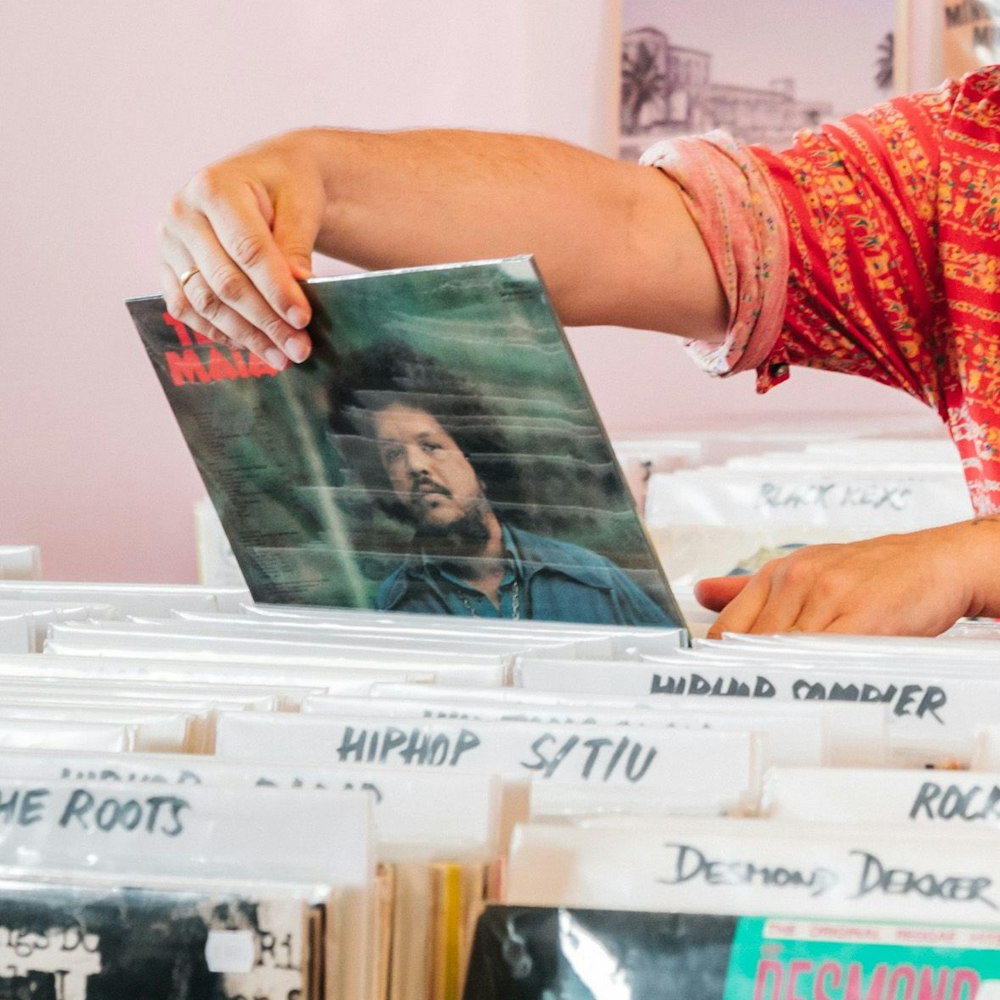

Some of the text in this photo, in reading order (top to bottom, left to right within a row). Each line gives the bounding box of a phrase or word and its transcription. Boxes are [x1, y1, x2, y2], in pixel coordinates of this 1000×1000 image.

[336, 726, 481, 767] HIPHOP
[0, 788, 192, 837] HE ROOTS
